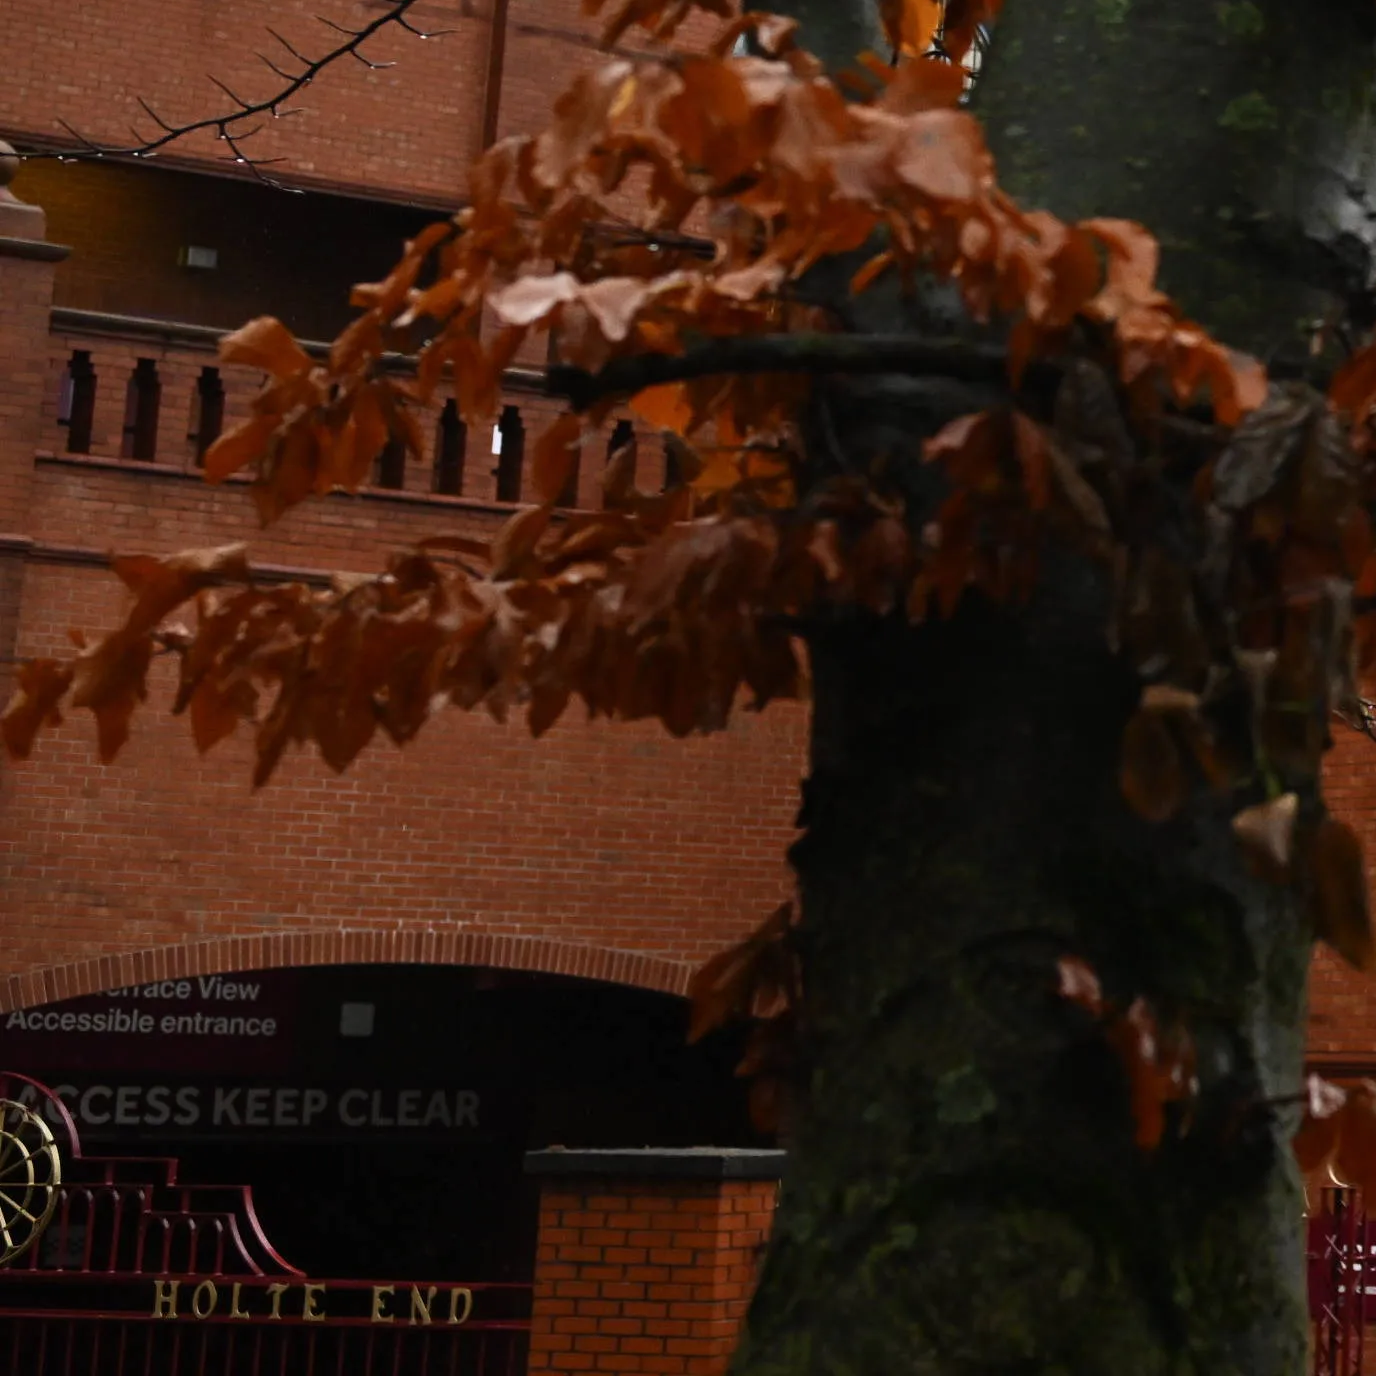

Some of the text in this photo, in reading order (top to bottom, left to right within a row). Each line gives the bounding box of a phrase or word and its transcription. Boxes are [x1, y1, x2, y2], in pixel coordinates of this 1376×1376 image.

[197, 975, 261, 1001] View
[5, 1008, 277, 1037] Accessible entrance
[7, 1084, 480, 1128] ACCESS KEEP CLEAR
[151, 1279, 475, 1326] HOLTE END
